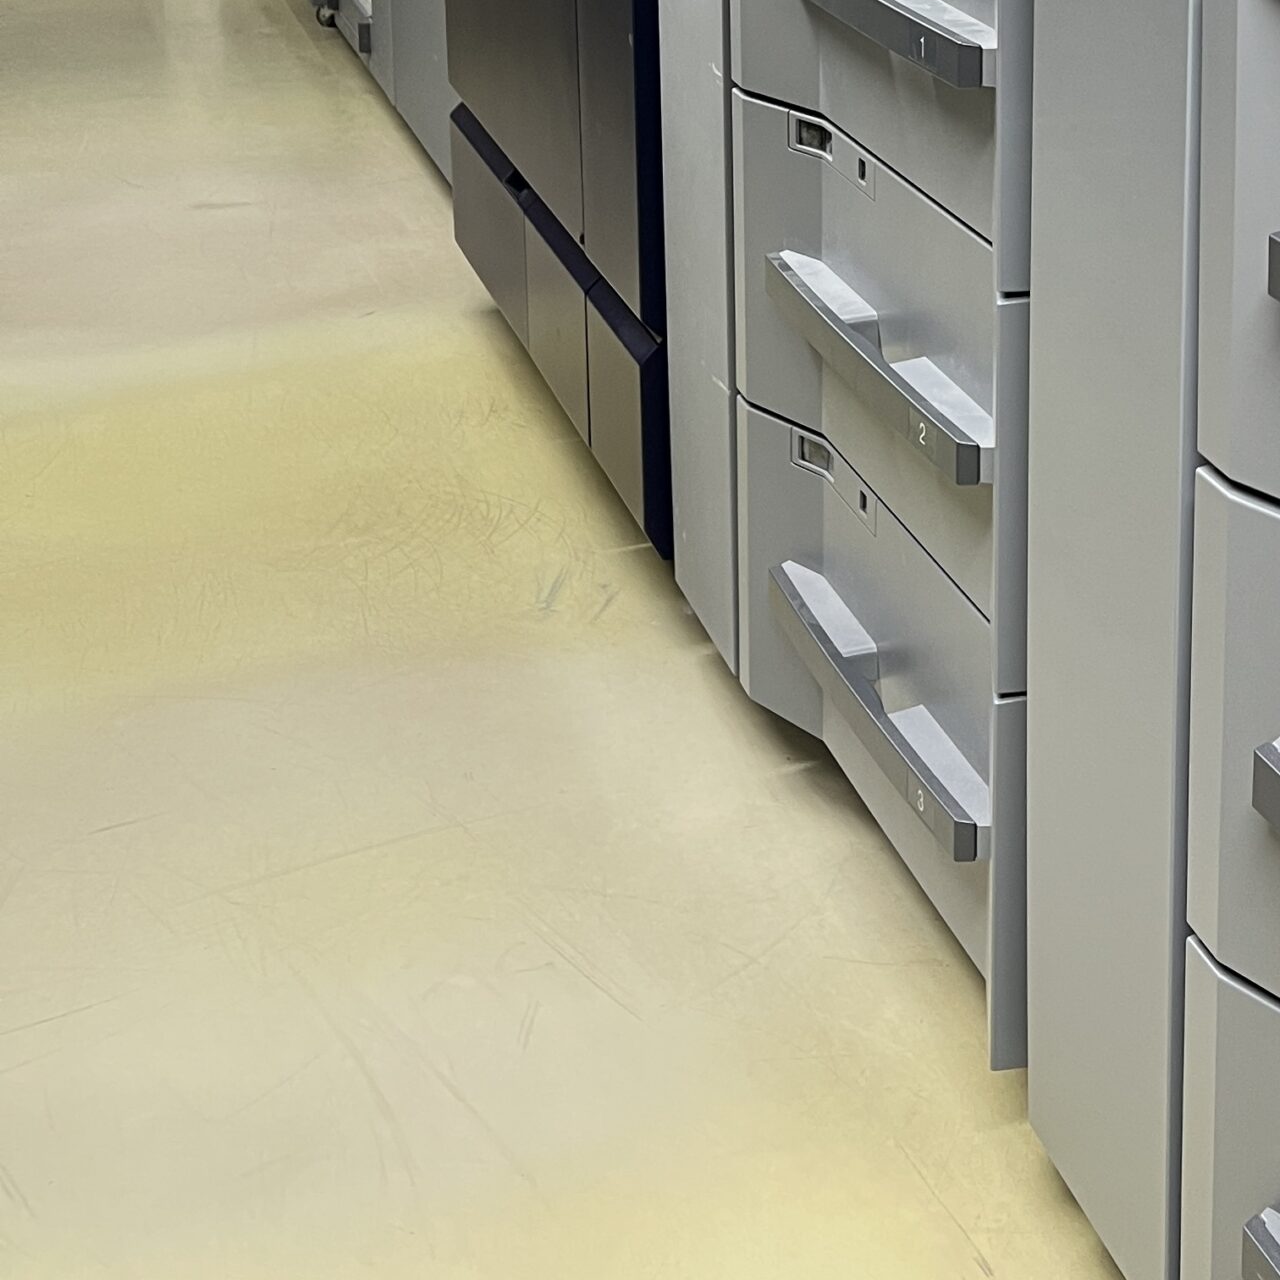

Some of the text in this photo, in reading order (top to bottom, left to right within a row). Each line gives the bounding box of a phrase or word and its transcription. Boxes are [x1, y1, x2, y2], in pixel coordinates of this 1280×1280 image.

[919, 35, 925, 59] 1
[919, 422, 926, 445] 2
[916, 789, 924, 812] 3
